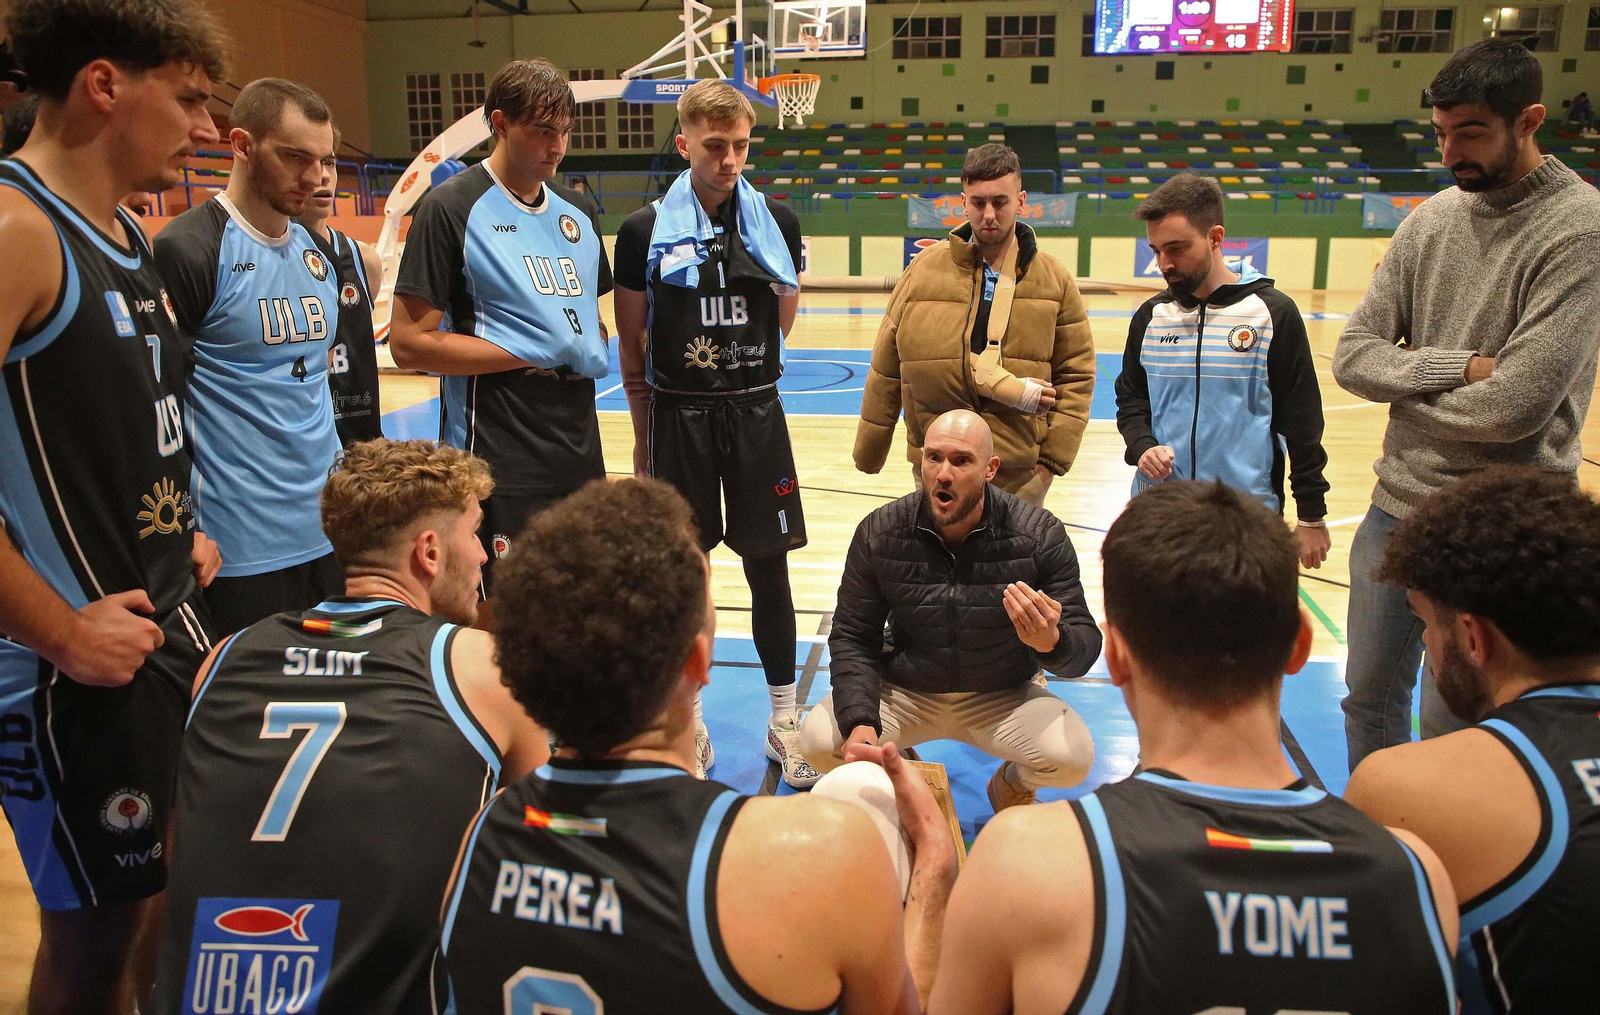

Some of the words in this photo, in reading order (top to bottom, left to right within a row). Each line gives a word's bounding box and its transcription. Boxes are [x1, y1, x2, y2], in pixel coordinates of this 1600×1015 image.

[492, 223, 518, 233] vive
[231, 260, 256, 273] vive
[522, 255, 584, 298] ULB
[717, 261, 726, 289] 1
[258, 295, 328, 346] ULB
[562, 307, 583, 336] 13
[700, 295, 749, 328] ULB
[1160, 332, 1180, 345] vive
[144, 333, 161, 383] 7
[290, 355, 308, 383] 4
[154, 393, 184, 458] ULB
[777, 509, 789, 534] 1
[282, 646, 370, 677] SLIM
[250, 701, 349, 842] 7
[114, 841, 163, 868] vive
[490, 860, 624, 936] PEREA
[1203, 890, 1354, 961] YOME
[191, 951, 316, 1015] UBAGO
